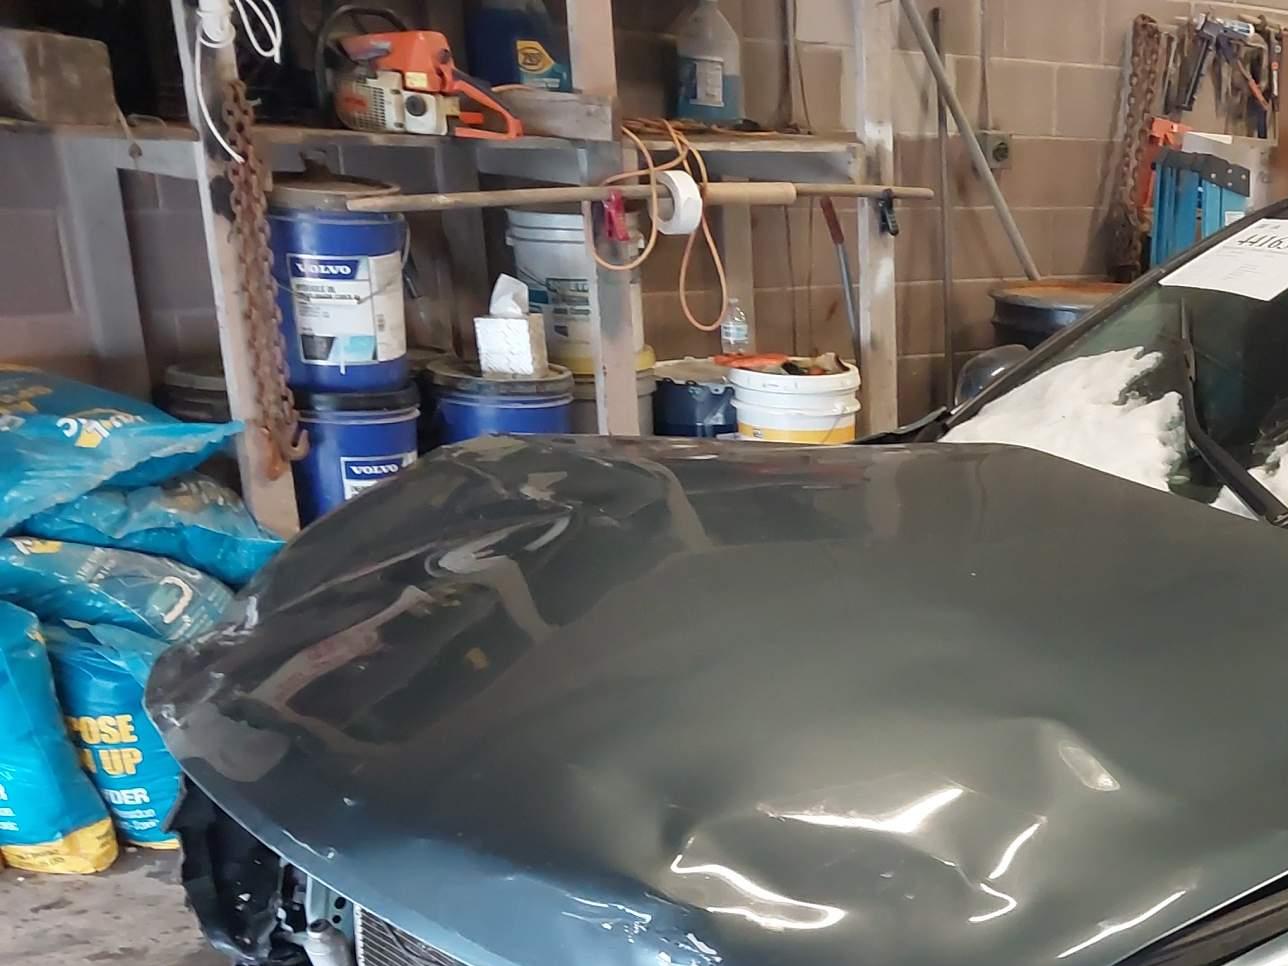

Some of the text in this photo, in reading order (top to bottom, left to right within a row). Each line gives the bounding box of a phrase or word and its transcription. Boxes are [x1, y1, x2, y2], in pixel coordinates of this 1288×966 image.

[295, 263, 352, 275] VOLVO
[349, 463, 399, 475] VOLVO
[99, 747, 143, 776] UP
